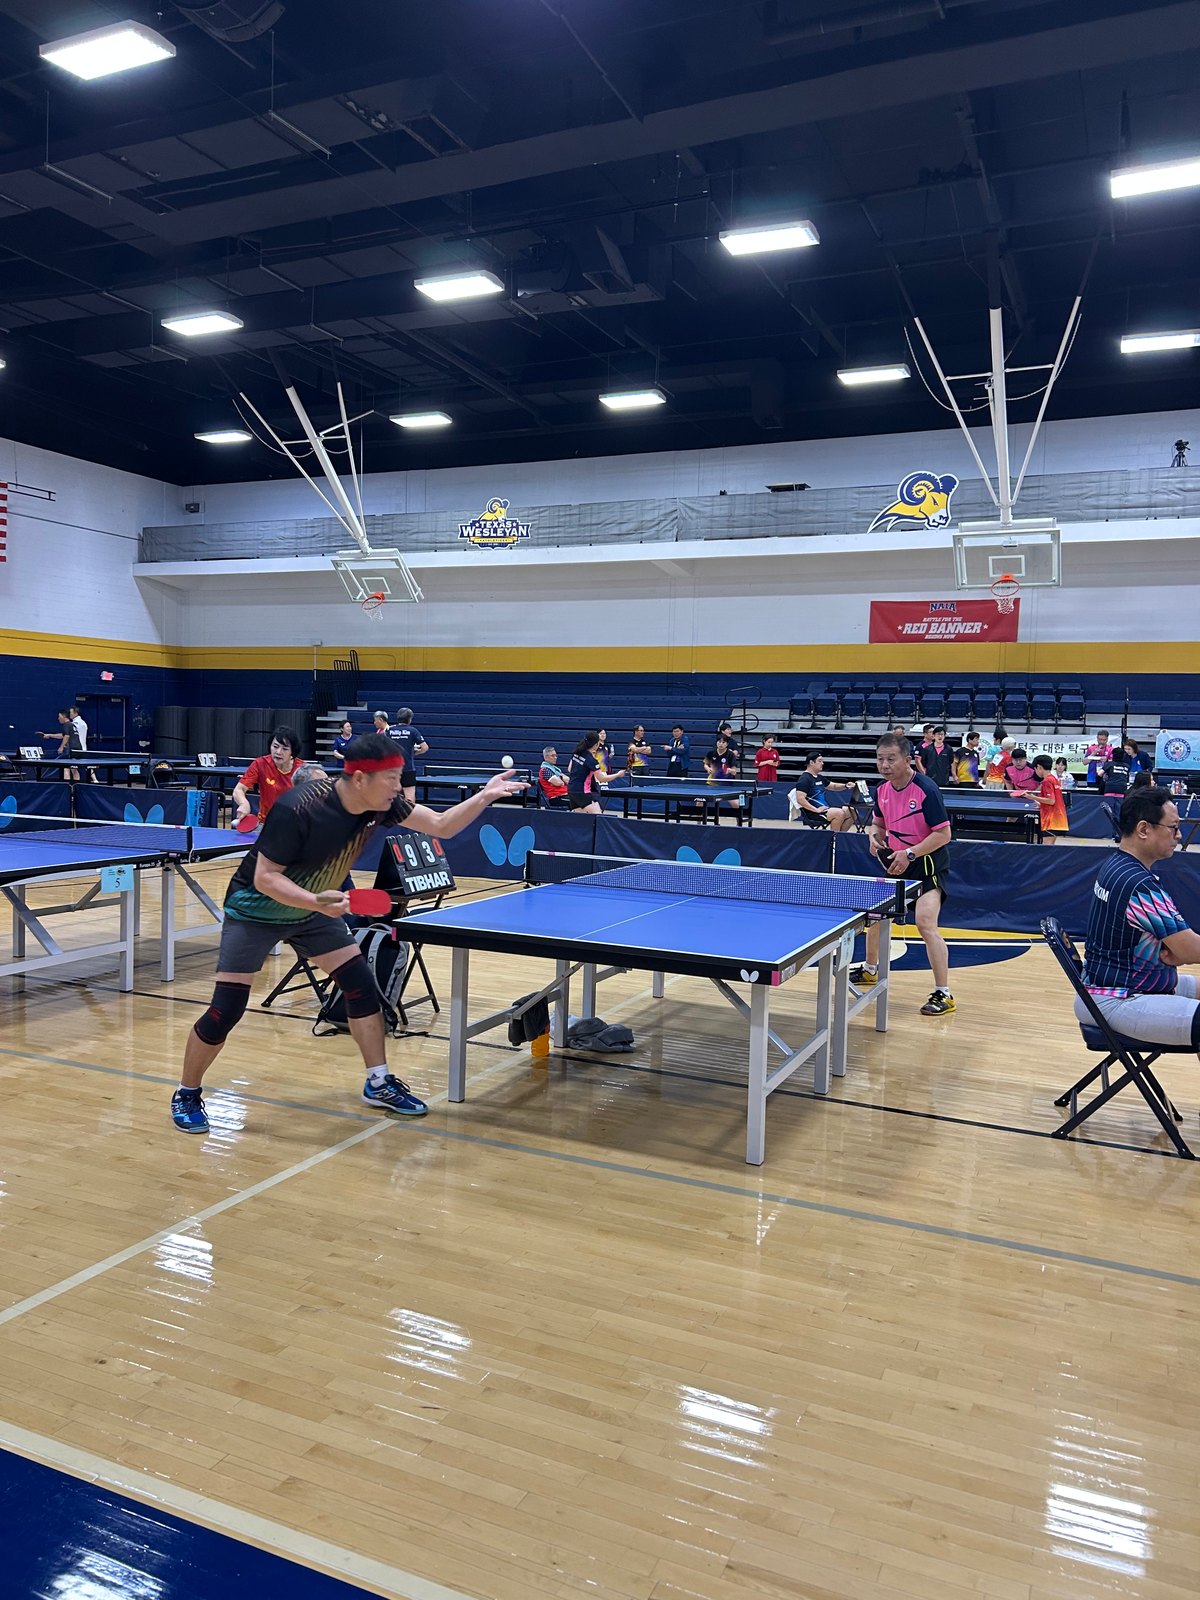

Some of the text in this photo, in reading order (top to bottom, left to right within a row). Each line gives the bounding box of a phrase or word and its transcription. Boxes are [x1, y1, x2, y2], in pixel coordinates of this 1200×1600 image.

[462, 526, 527, 536] WESLEYAN
[929, 601, 957, 613] NAIA
[902, 622, 981, 634] RED BANNER
[1042, 742, 1064, 754] 대한
[404, 843, 418, 867] 9
[421, 840, 436, 863] 3
[115, 877, 121, 888] 5
[404, 871, 451, 893] TIBHAR
